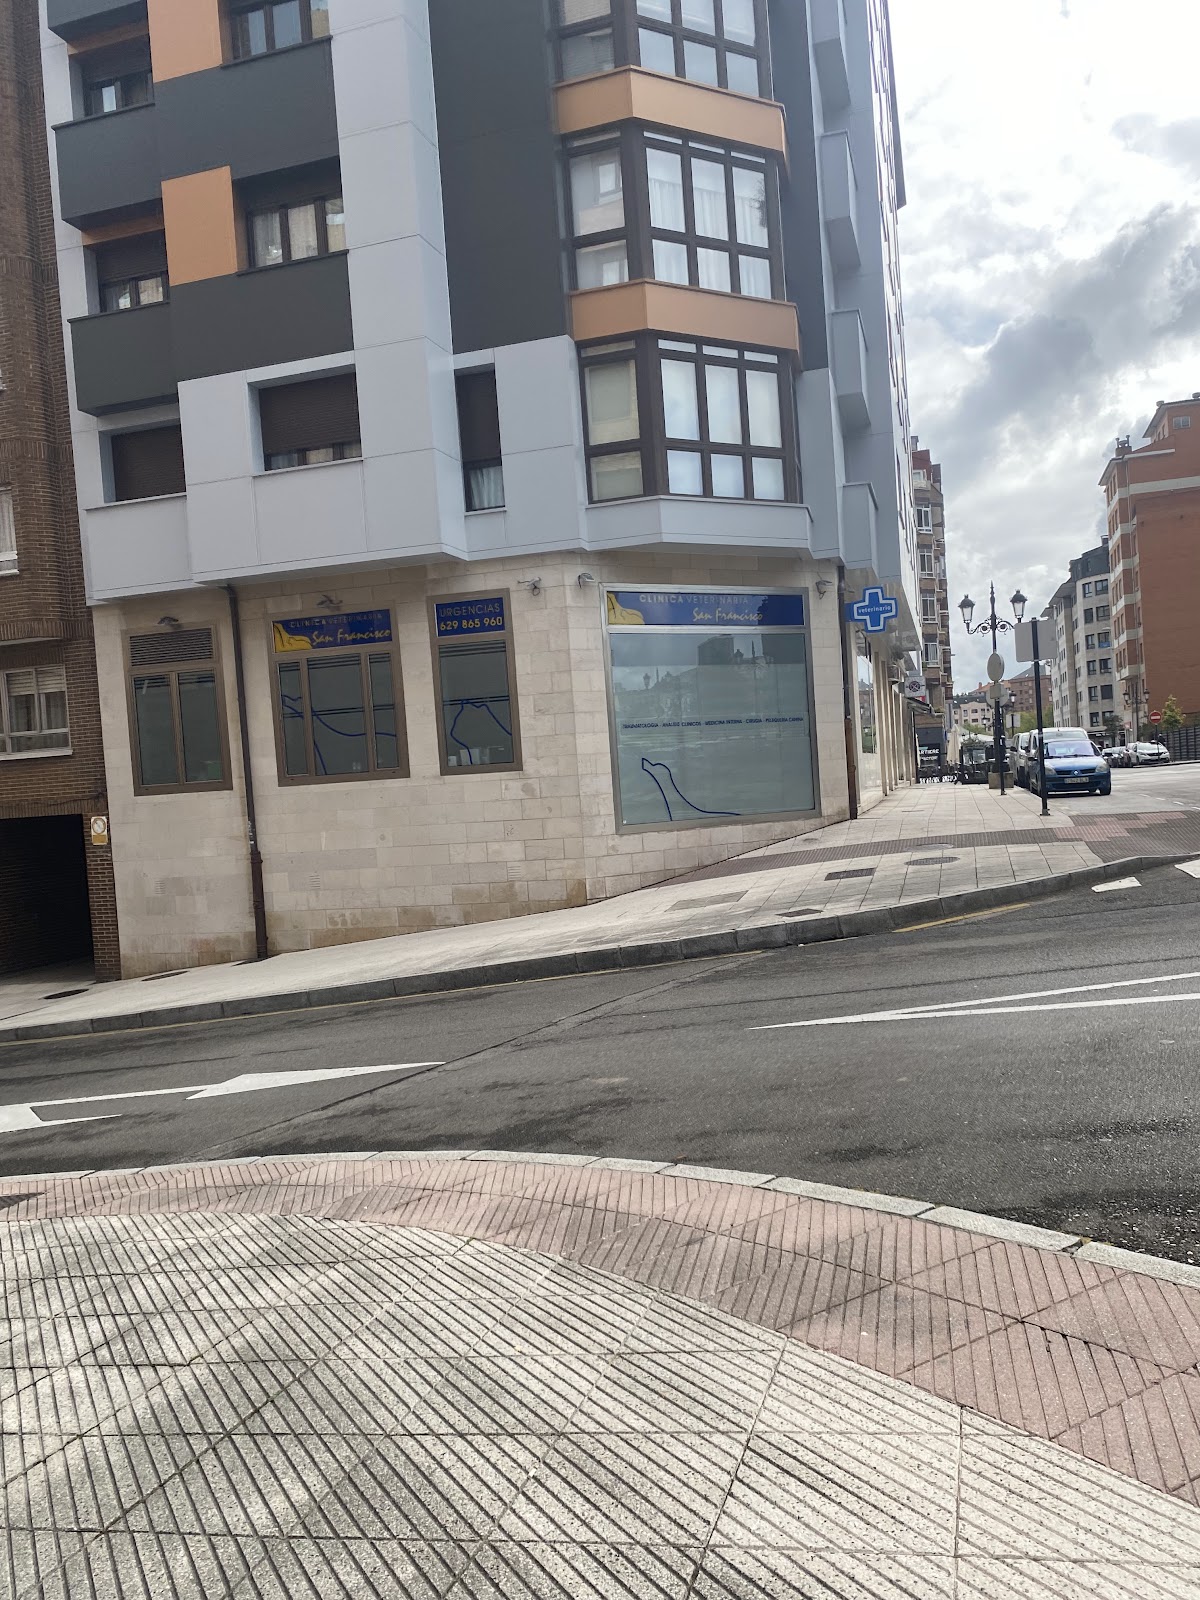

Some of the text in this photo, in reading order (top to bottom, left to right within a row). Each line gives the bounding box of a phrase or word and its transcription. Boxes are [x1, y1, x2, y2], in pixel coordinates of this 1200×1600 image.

[639, 594, 684, 604] CLINICA
[440, 603, 501, 617] URGENCIAS
[692, 607, 763, 622] San Francisco
[858, 605, 892, 613] veterinario
[290, 618, 327, 628] CLINICA
[440, 616, 503, 631] 629 865 960
[312, 628, 391, 645] San Francisco
